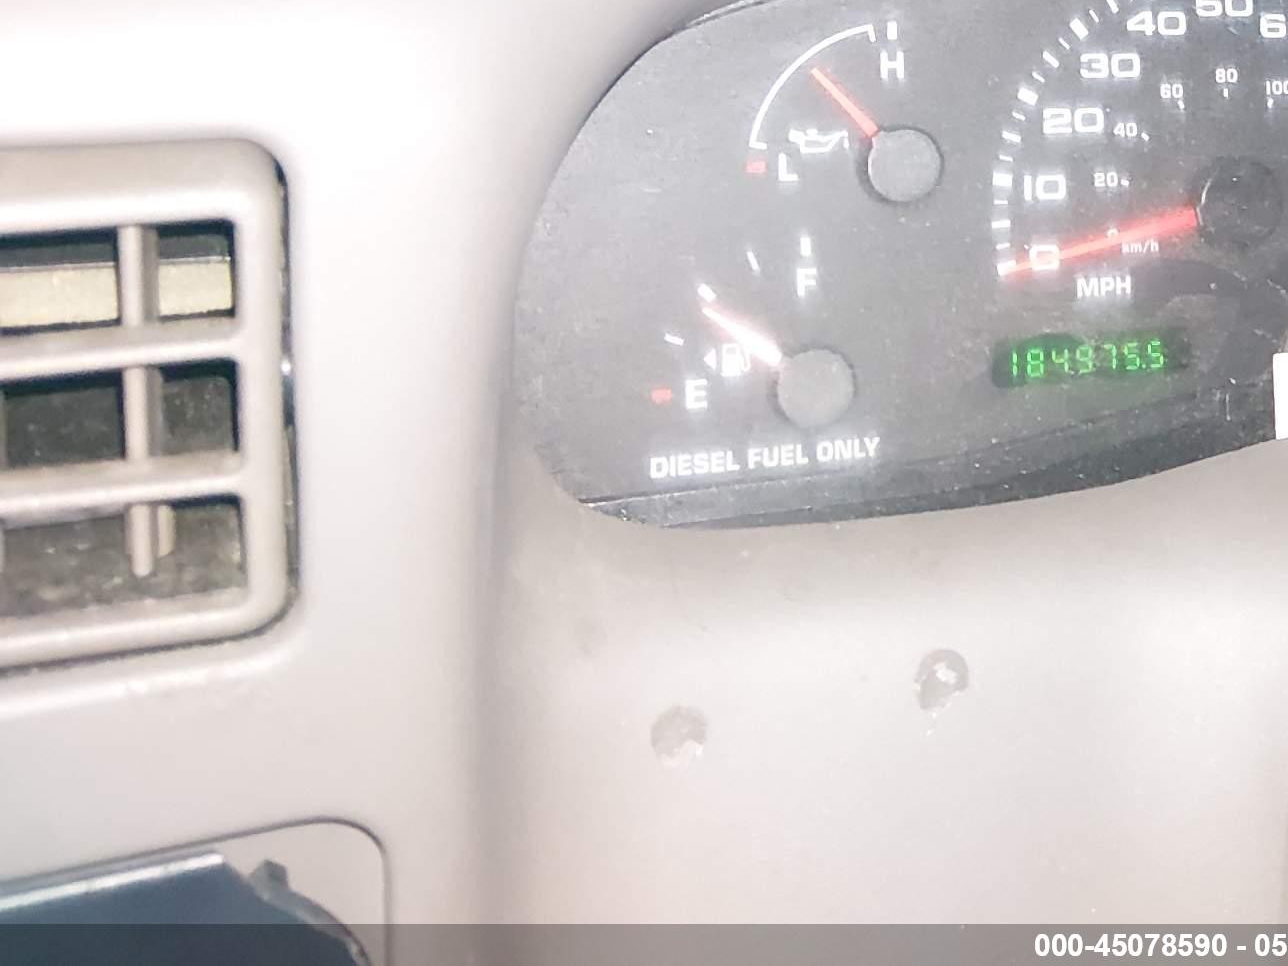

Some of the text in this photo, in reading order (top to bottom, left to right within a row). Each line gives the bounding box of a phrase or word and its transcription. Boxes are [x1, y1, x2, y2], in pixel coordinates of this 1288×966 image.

[1127, 11, 1186, 35] 40
[880, 50, 904, 81] H
[1080, 53, 1140, 80] 30
[1216, 68, 1237, 83] 80
[1161, 83, 1183, 98] 60
[1043, 107, 1103, 133] 20
[1114, 122, 1137, 137] 40
[778, 153, 798, 181] L
[1094, 172, 1118, 187] 20
[1024, 174, 1066, 201] 10
[1029, 244, 1060, 270] 0
[1121, 238, 1158, 253] km/h
[797, 267, 816, 296] F
[1077, 276, 1130, 298] MPH
[685, 379, 707, 409] E
[651, 437, 879, 478] DIESEL FUEL ONLY
